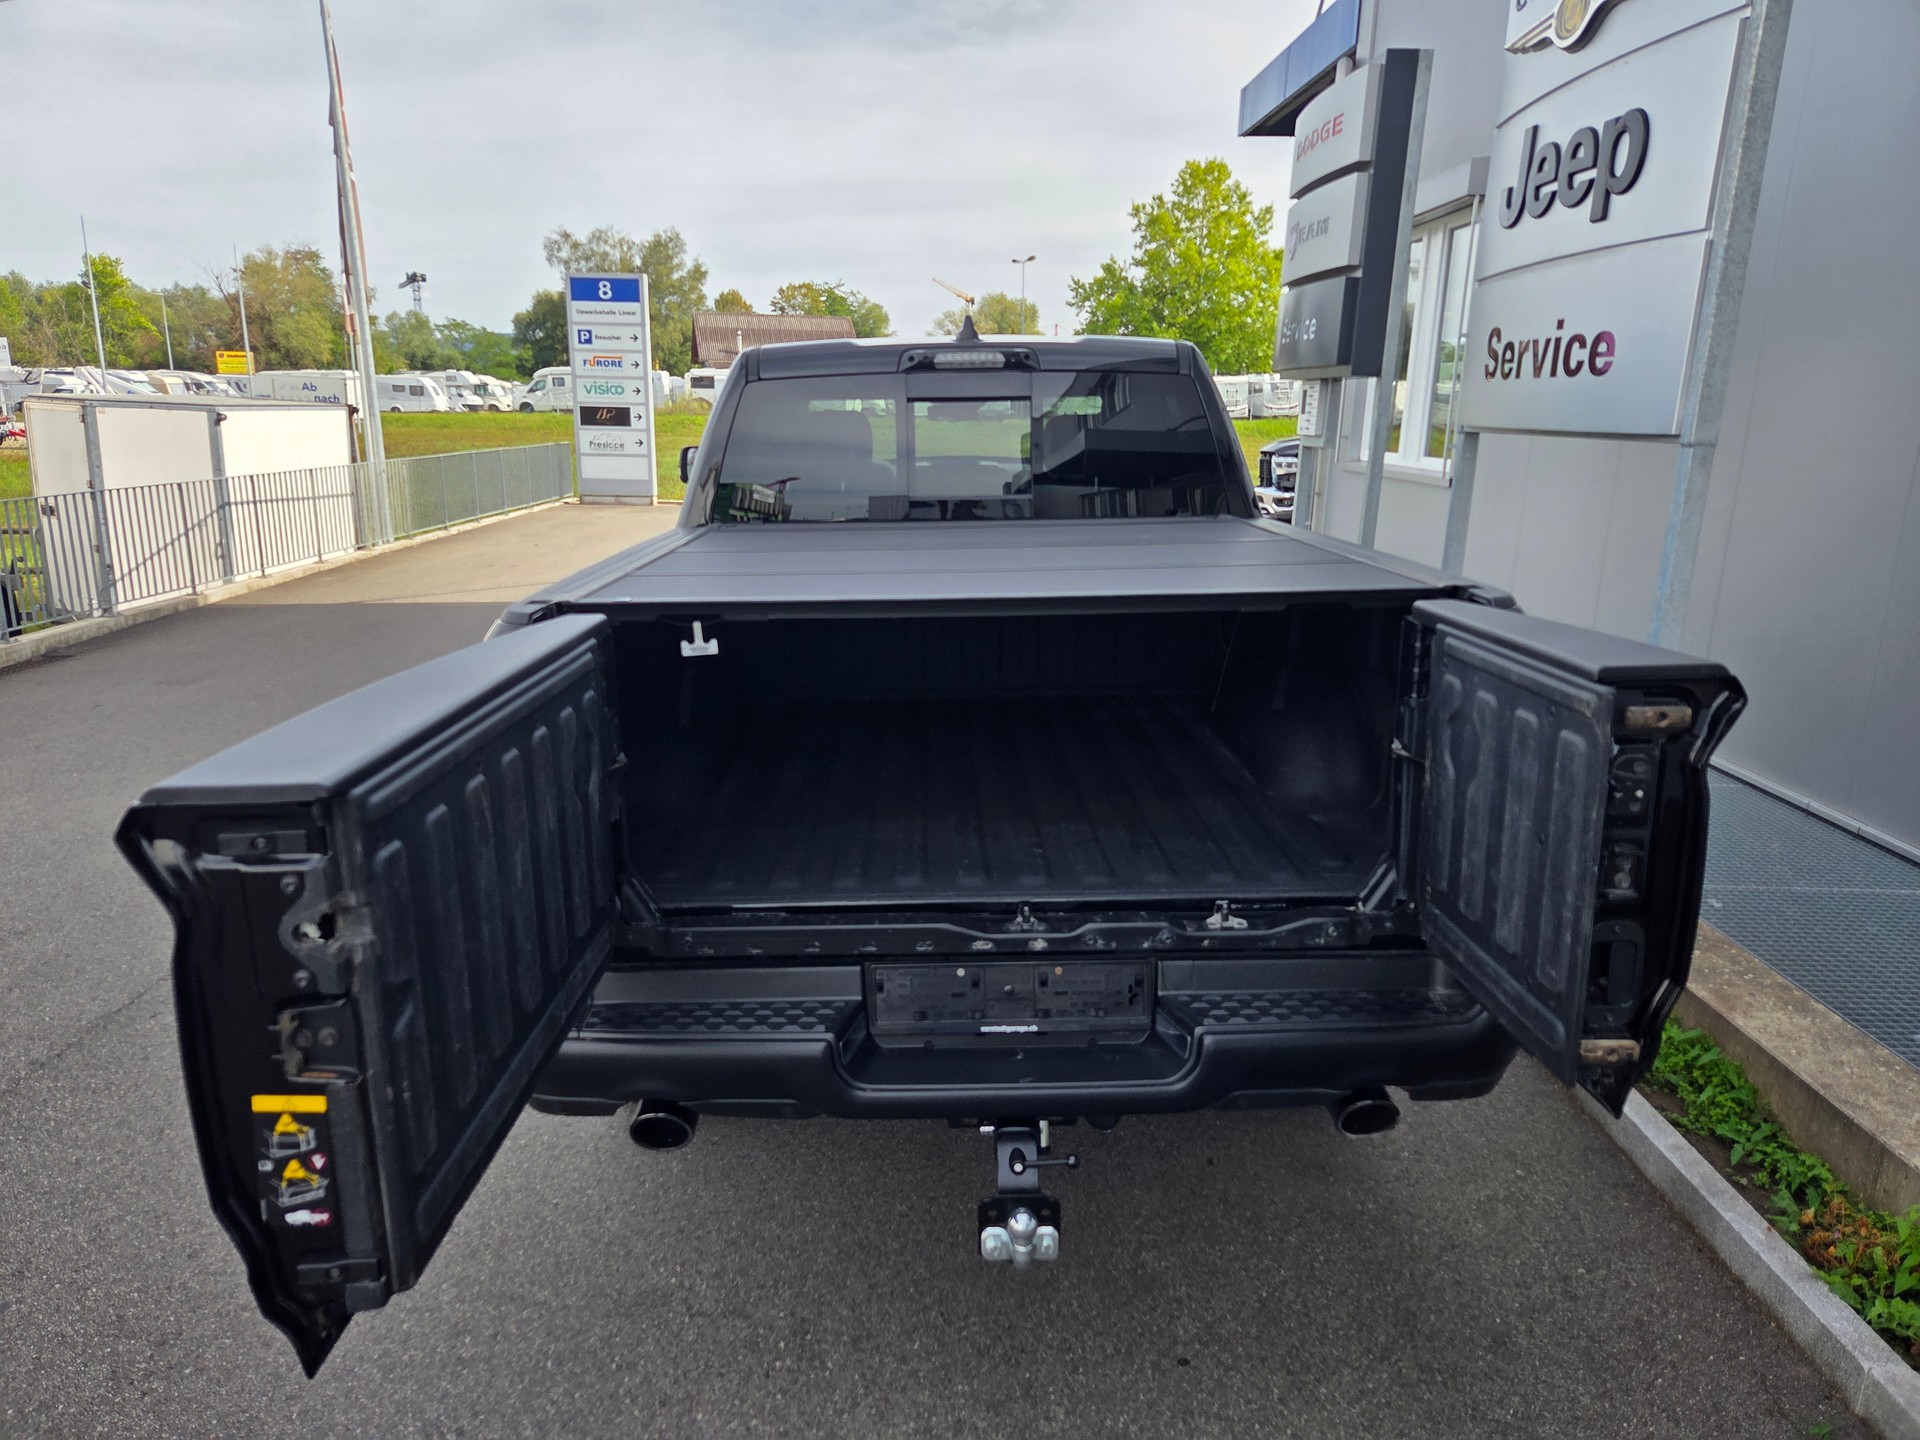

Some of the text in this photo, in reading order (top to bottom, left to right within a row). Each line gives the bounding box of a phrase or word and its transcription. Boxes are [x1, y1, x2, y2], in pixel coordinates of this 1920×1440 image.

[1296, 112, 1344, 162] DODGE
[1500, 107, 1650, 229] Jeep
[1299, 216, 1330, 244] RAM
[598, 280, 613, 300] 8
[1484, 319, 1616, 382] Service
[582, 356, 623, 368] FURORE
[301, 382, 318, 392] Ab
[583, 380, 625, 396] visico
[314, 393, 341, 404] nach
